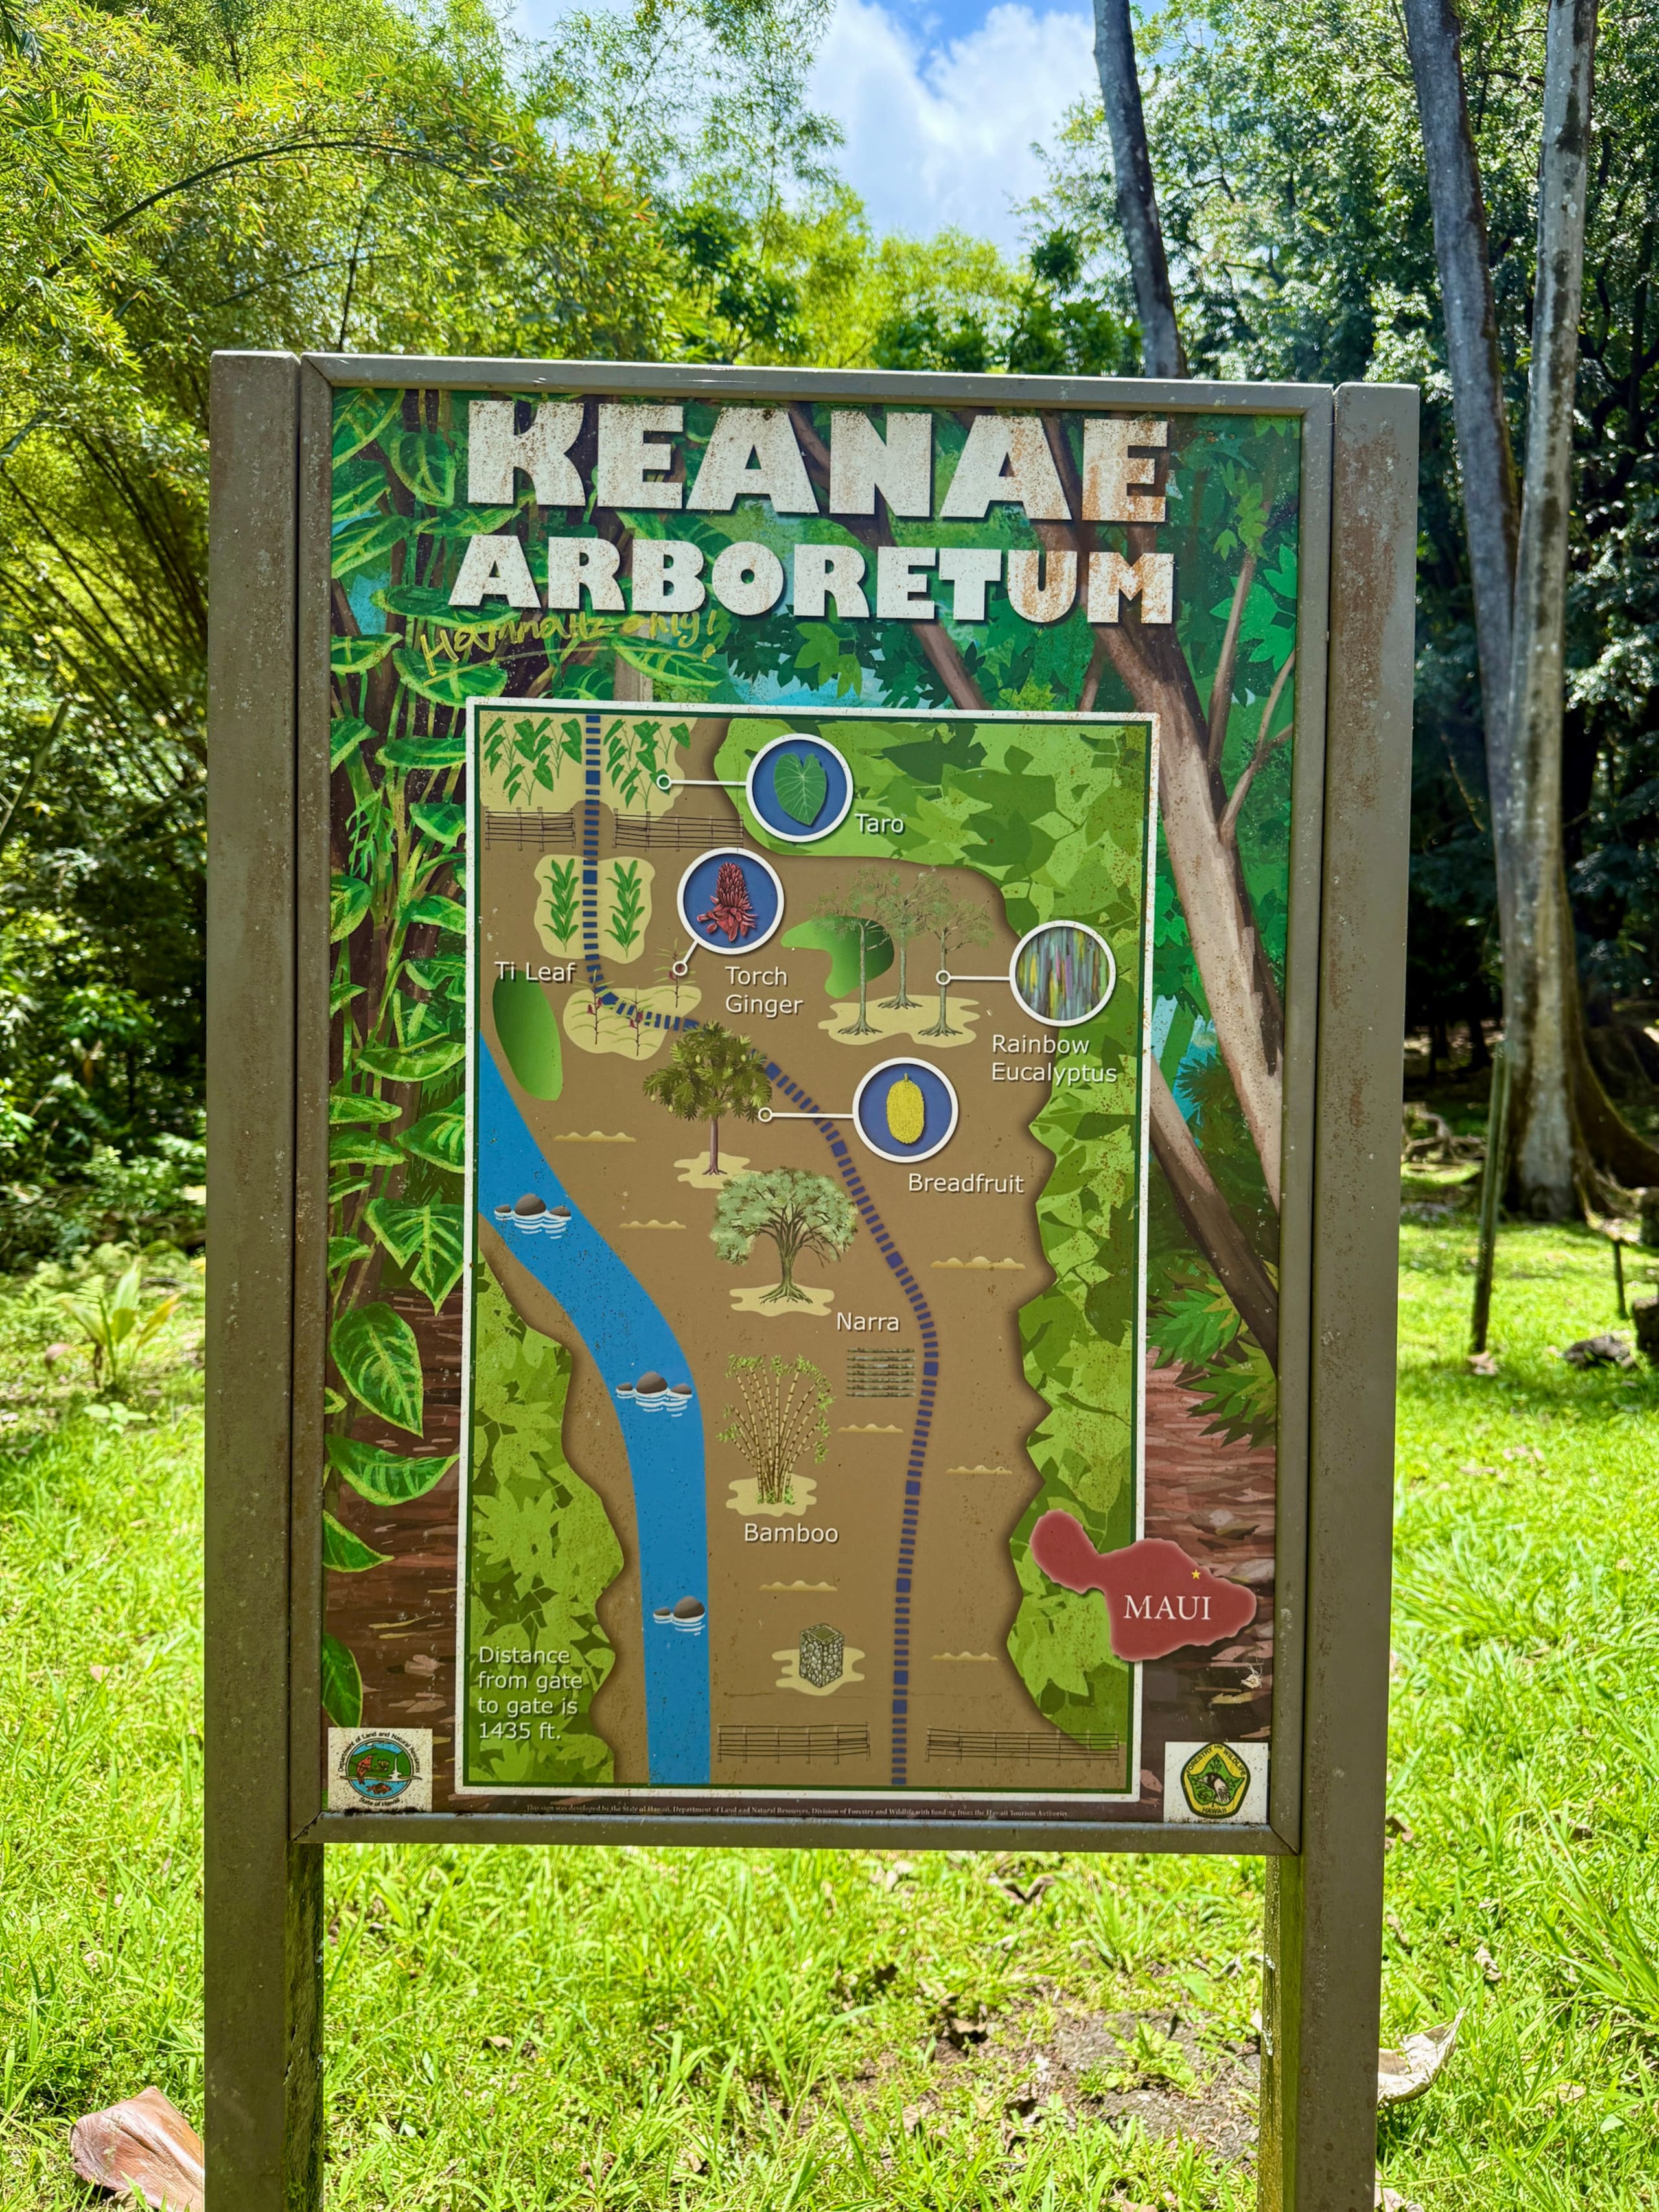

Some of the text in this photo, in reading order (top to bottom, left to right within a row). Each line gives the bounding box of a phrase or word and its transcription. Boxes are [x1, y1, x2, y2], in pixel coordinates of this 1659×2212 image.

[467, 399, 1168, 522] KEANAE
[448, 534, 1174, 624] ARBORETUM
[854, 813, 904, 833] Taro
[494, 961, 576, 983] Ti Leaf
[725, 966, 788, 986] Torch
[725, 994, 804, 1019] Ginger
[992, 1034, 1090, 1054] Rainbow
[992, 1062, 1118, 1086] Eucalyptus
[908, 1172, 1026, 1194] Breadfruit
[836, 1311, 900, 1331] Narra
[744, 1522, 839, 1543] Bamboo
[1123, 1594, 1212, 1620] MAUI
[479, 1646, 570, 1664] Distance
[478, 1670, 583, 1694] from gate
[478, 1697, 579, 1718] to gate is
[478, 1721, 562, 1740] 1435 ft.
[1186, 1747, 1213, 1775] FORESTRY
[1223, 1749, 1247, 1776] WILDLIFE
[1202, 1806, 1227, 1815] HAWAII
